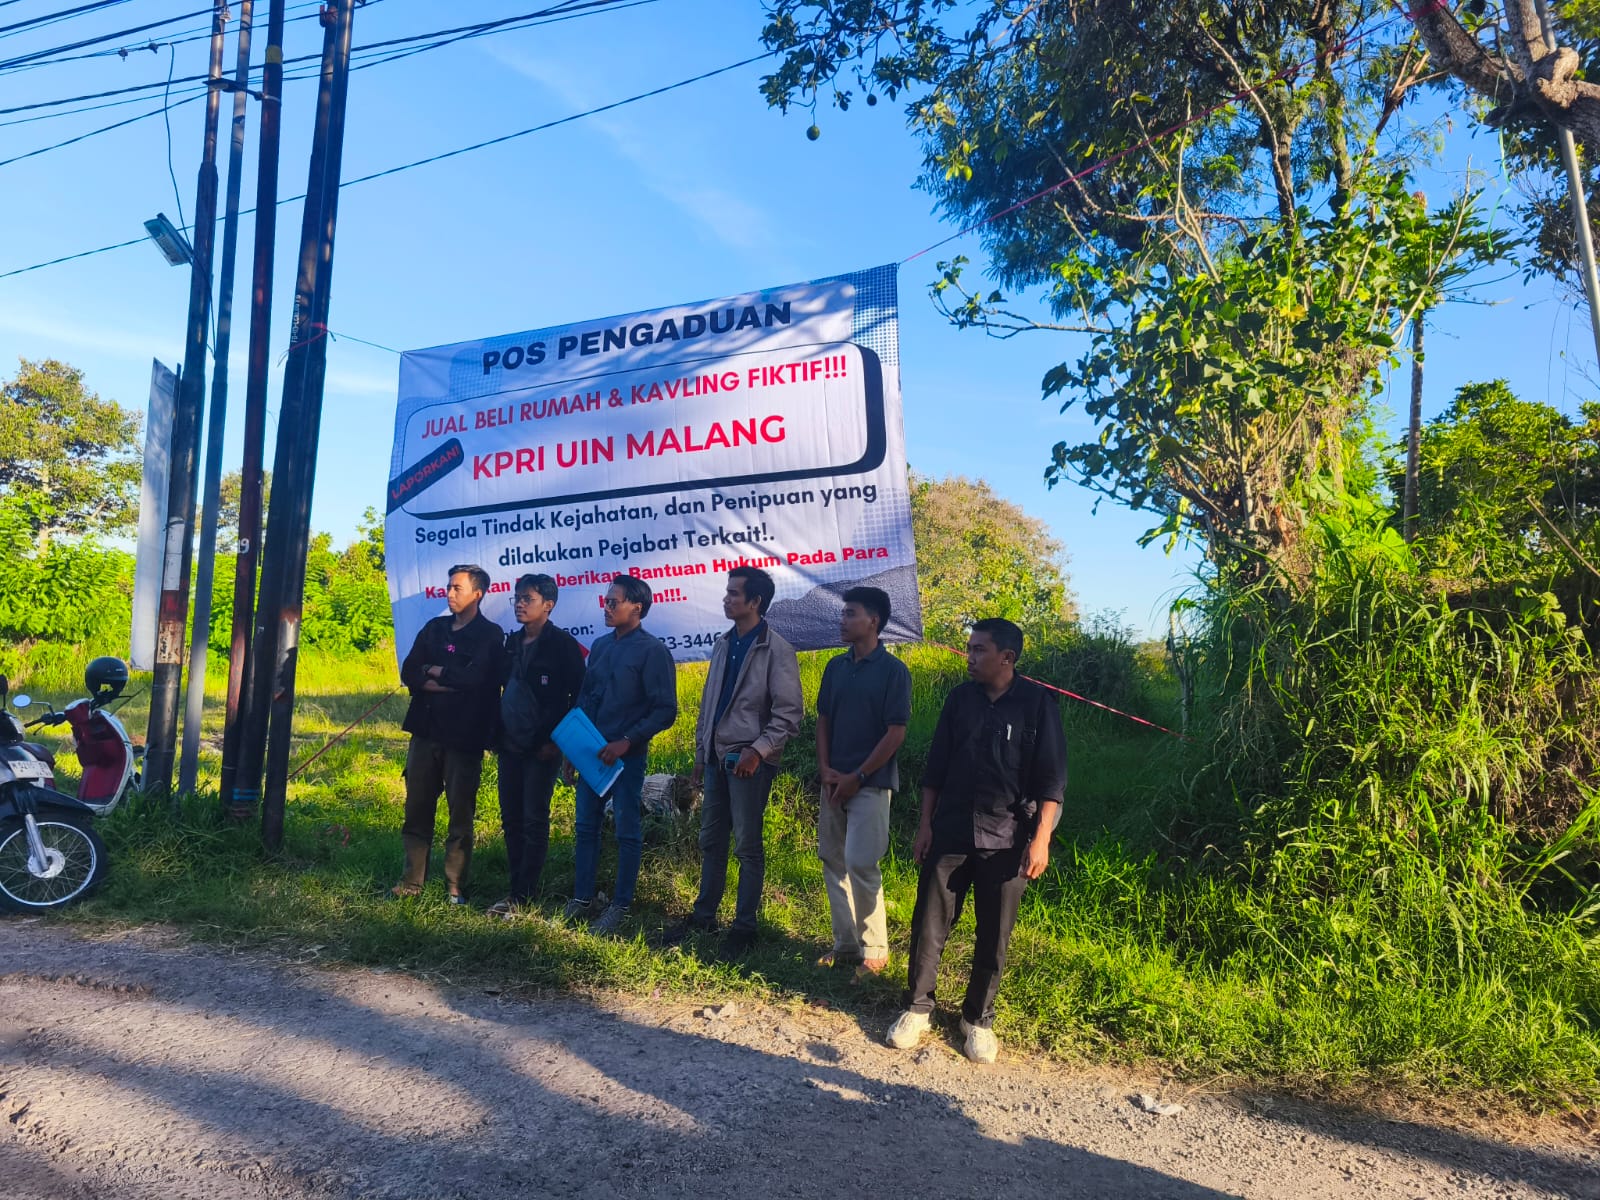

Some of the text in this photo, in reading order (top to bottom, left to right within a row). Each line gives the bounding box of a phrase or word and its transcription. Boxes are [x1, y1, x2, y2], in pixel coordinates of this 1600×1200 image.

[483, 302, 791, 375] POS PENGADUAN
[422, 355, 848, 439] JUAL BELI RUMAH & KAVLING FIKTIF!!!
[473, 415, 786, 480] KPRI UIN MALANG
[415, 484, 877, 546] Segala Tindak Kejahatan, dan Penipuan yang
[499, 522, 775, 566] dilakukan Pejabat Terkait!.
[628, 563, 707, 581] Bantuan
[712, 555, 781, 573] Hukum
[787, 550, 836, 565] Pada
[842, 545, 889, 561] Para
